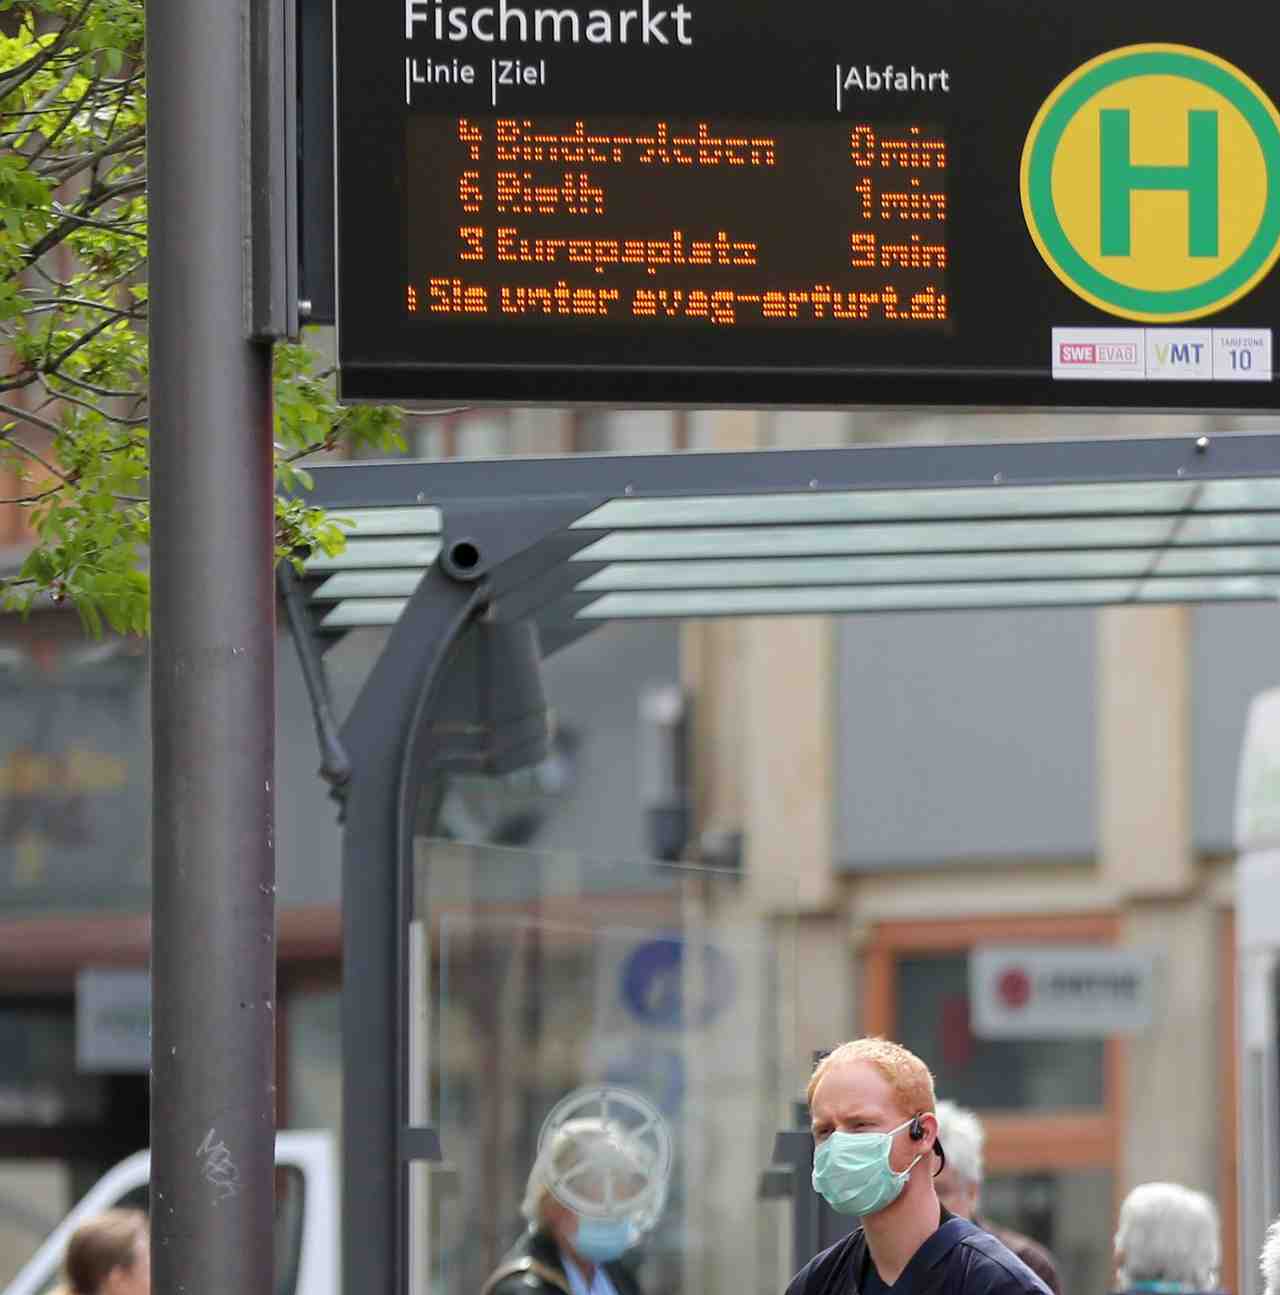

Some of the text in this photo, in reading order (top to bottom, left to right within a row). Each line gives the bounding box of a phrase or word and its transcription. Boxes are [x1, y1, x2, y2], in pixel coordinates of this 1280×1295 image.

[404, 0, 692, 45] Fischmarkt
[412, 58, 949, 92] Linie Ziel Abfahrt
[459, 119, 483, 161] 4
[459, 171, 483, 213] 6
[497, 171, 604, 214] Rieth
[1099, 109, 1219, 258] H
[459, 227, 484, 261] 3
[497, 227, 758, 274] Europaplatz
[430, 279, 488, 313] Sie
[501, 281, 620, 316] unter
[1061, 344, 1093, 361] SWE
[1155, 343, 1204, 364] VMT
[1228, 349, 1252, 371] 10
